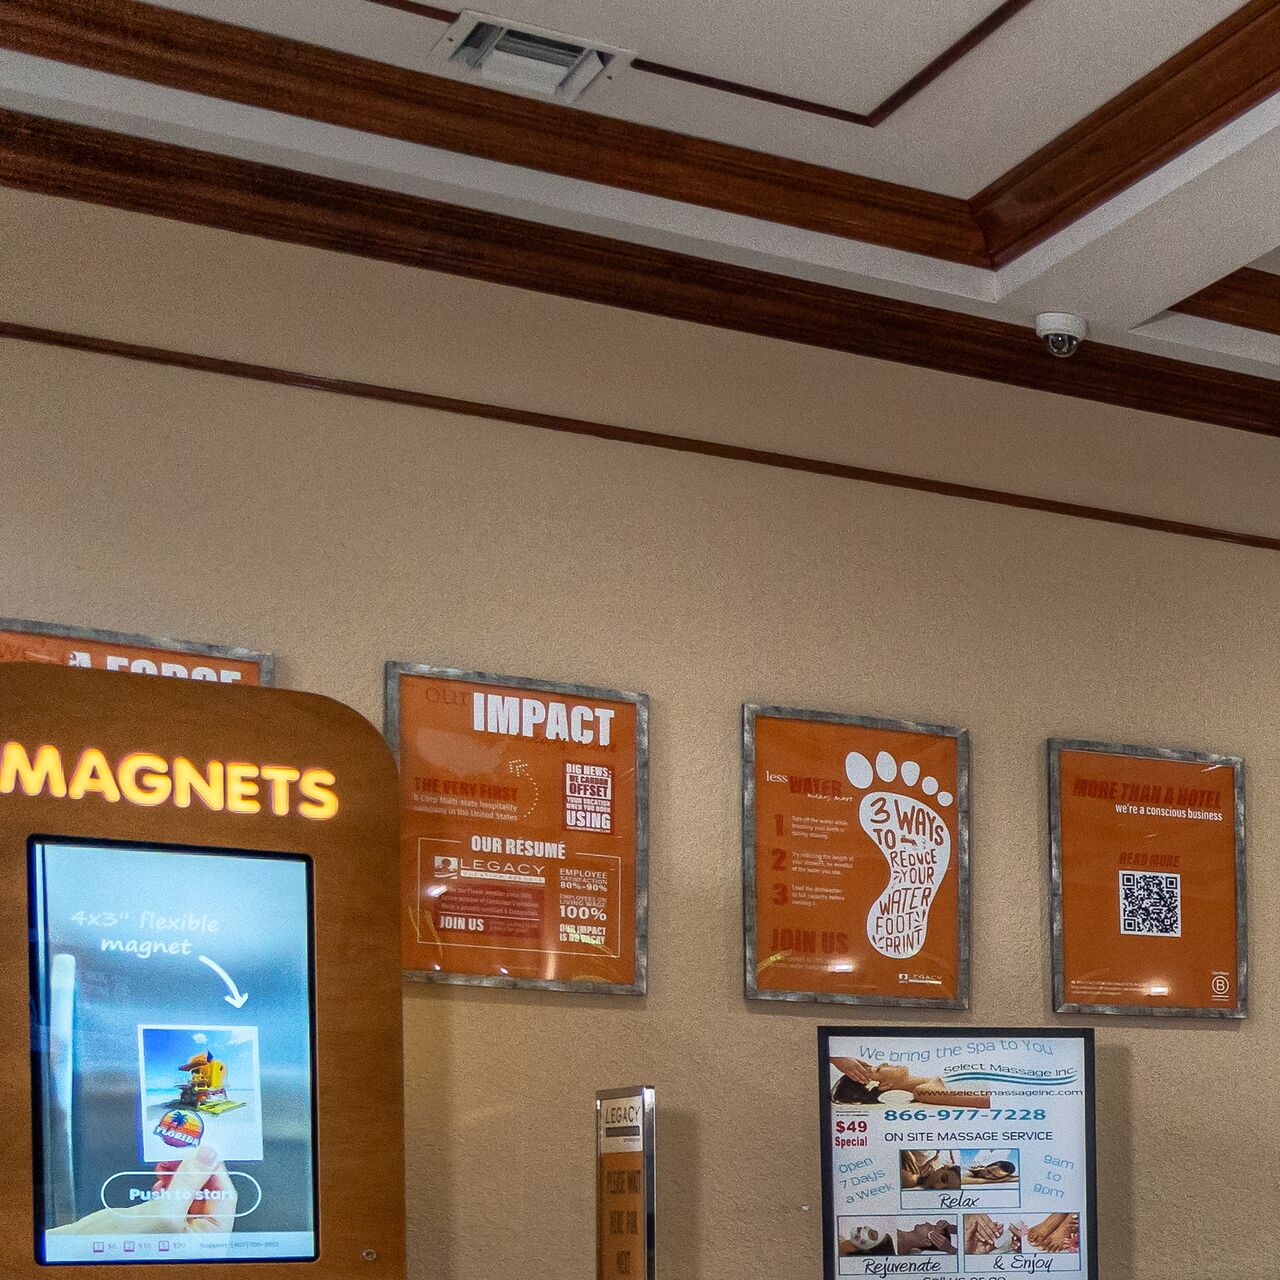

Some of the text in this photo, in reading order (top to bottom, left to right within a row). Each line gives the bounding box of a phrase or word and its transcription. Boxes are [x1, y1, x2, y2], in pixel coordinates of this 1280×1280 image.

[473, 692, 615, 746] IMPACT
[566, 763, 582, 774] BIG
[765, 770, 789, 783] less
[0, 741, 340, 821] MAGNETS
[569, 782, 609, 798] OFFSET
[1119, 782, 1162, 805] THAN
[1163, 785, 1176, 806] A
[1177, 787, 1222, 810] HOTEL
[566, 810, 611, 829] USING
[869, 797, 944, 847] 3 WAYS
[1115, 803, 1224, 822] we're a conscious business
[471, 835, 502, 854] OUR
[872, 828, 897, 850] TO
[460, 858, 546, 876] LEGACY
[771, 847, 787, 871] 2
[889, 848, 937, 868] REDUCE
[560, 868, 608, 880] EMPLOYEE
[900, 866, 935, 886] YOUR
[772, 882, 788, 906] 3
[879, 886, 932, 917] WATER
[138, 911, 220, 932] flexible
[559, 905, 607, 921] 100%
[439, 916, 467, 930] JOIN
[468, 918, 485, 932] US
[559, 923, 607, 936] OUR IMPACT
[875, 911, 914, 936] FOOT
[101, 938, 193, 959] magnet
[885, 928, 922, 955] PRINT
[1215, 979, 1225, 991] B
[859, 1039, 1054, 1063] We bring the Spa to You
[989, 1063, 1052, 1078] Massage
[915, 1089, 1084, 1097] www.selectmassageinc.com
[605, 1105, 641, 1124] LEGACY
[884, 1109, 1047, 1121] 866-977-7228
[155, 1126, 200, 1146] FLORIDA
[835, 1120, 868, 1134] $49
[884, 1131, 1053, 1142] ON SITE MASSAGE SERVICE
[834, 1136, 868, 1149] Special
[838, 1157, 874, 1174] Open
[839, 1169, 886, 1190] 7 Days
[1046, 1171, 1062, 1183] to
[128, 1188, 235, 1201] Push to start
[846, 1182, 895, 1204] a Week
[938, 1190, 980, 1209] Relax
[862, 1256, 942, 1279] Rejuvenate
[992, 1252, 1054, 1275] & Enjoy
